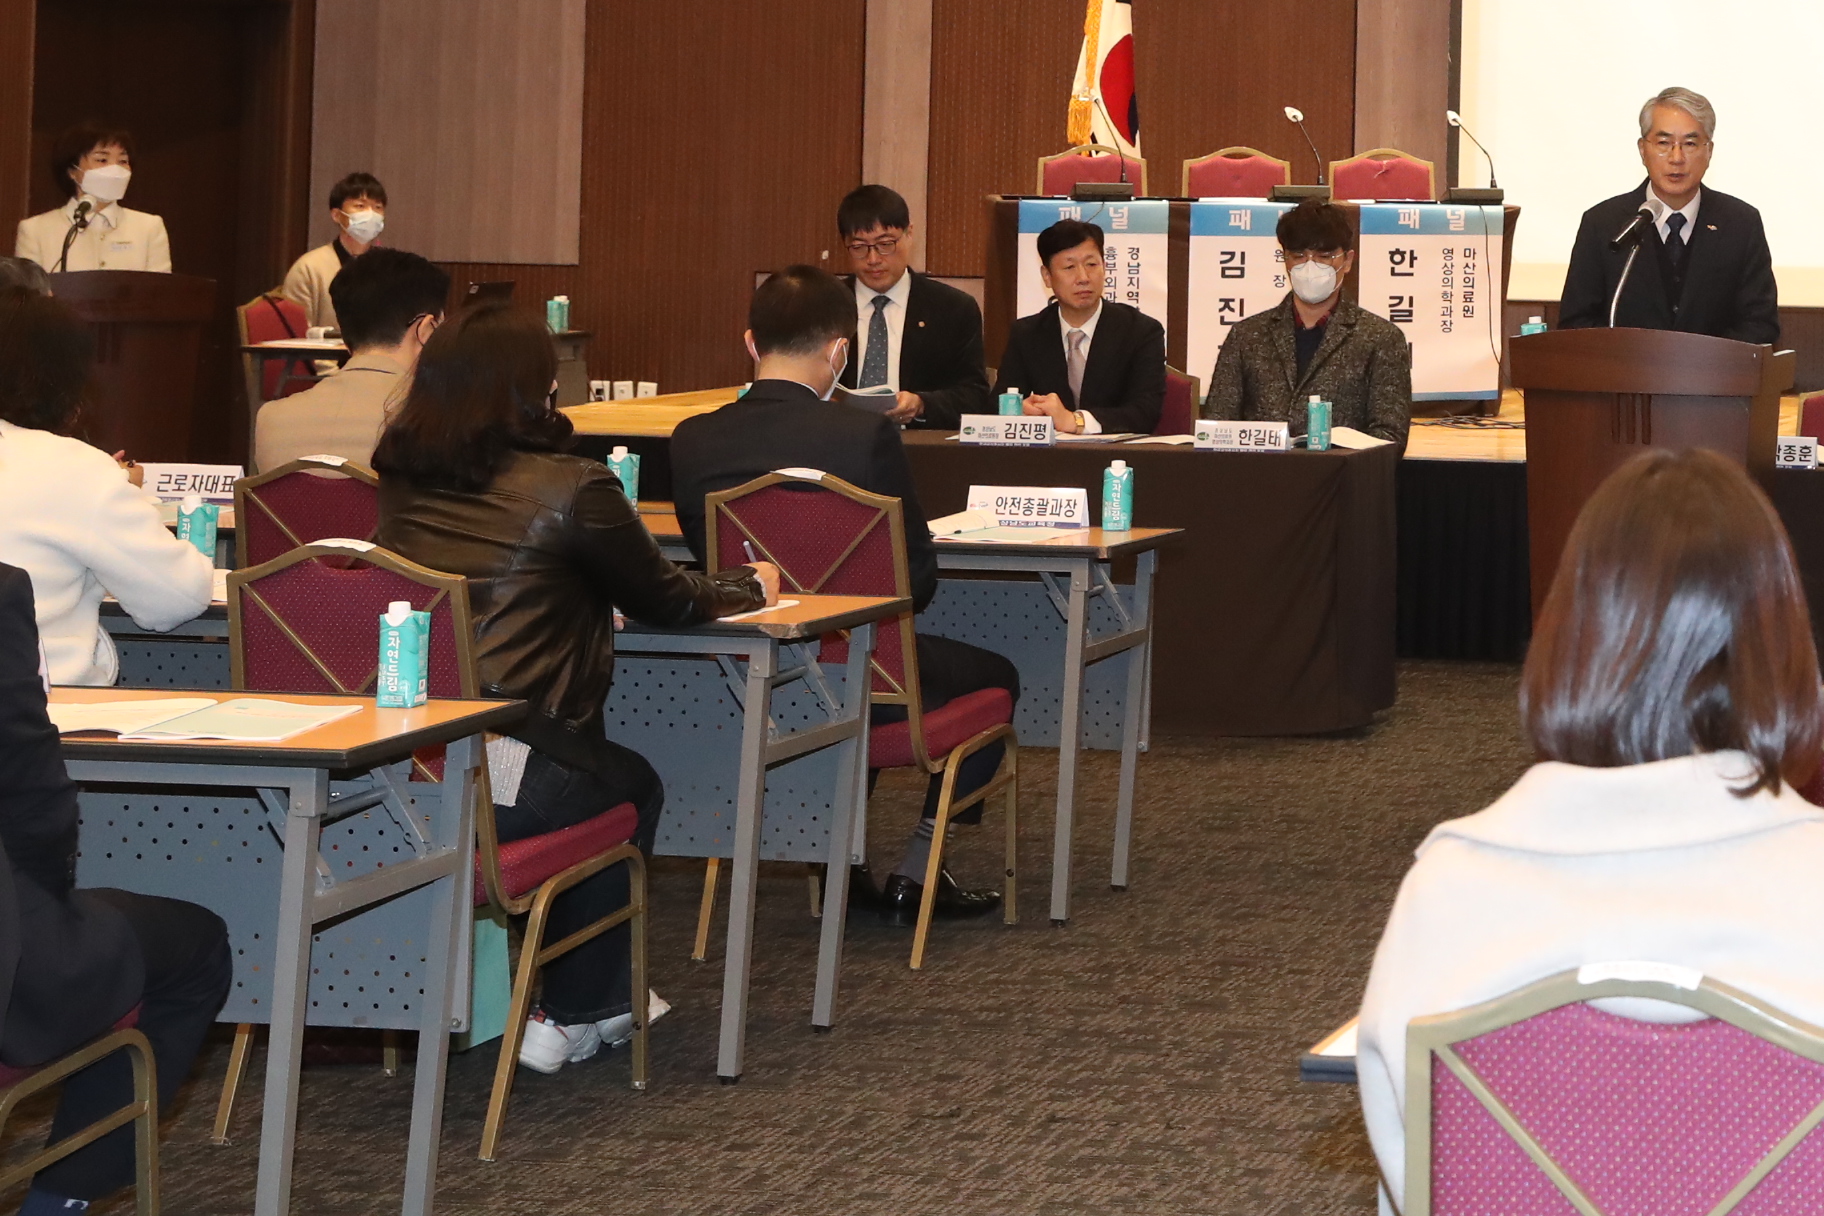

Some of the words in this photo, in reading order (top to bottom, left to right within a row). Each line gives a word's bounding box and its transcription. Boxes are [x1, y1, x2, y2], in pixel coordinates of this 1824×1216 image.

[1441, 248, 1454, 333] 영상의학과장
[1462, 248, 1476, 318] 마산의료원
[1388, 248, 1417, 370] 한길
[1005, 423, 1046, 440] 김진평
[1239, 429, 1281, 446] 한길태
[157, 474, 235, 493] 근로자대표
[995, 496, 1077, 517] 안전총괄과장
[386, 636, 400, 692] 자연드림
